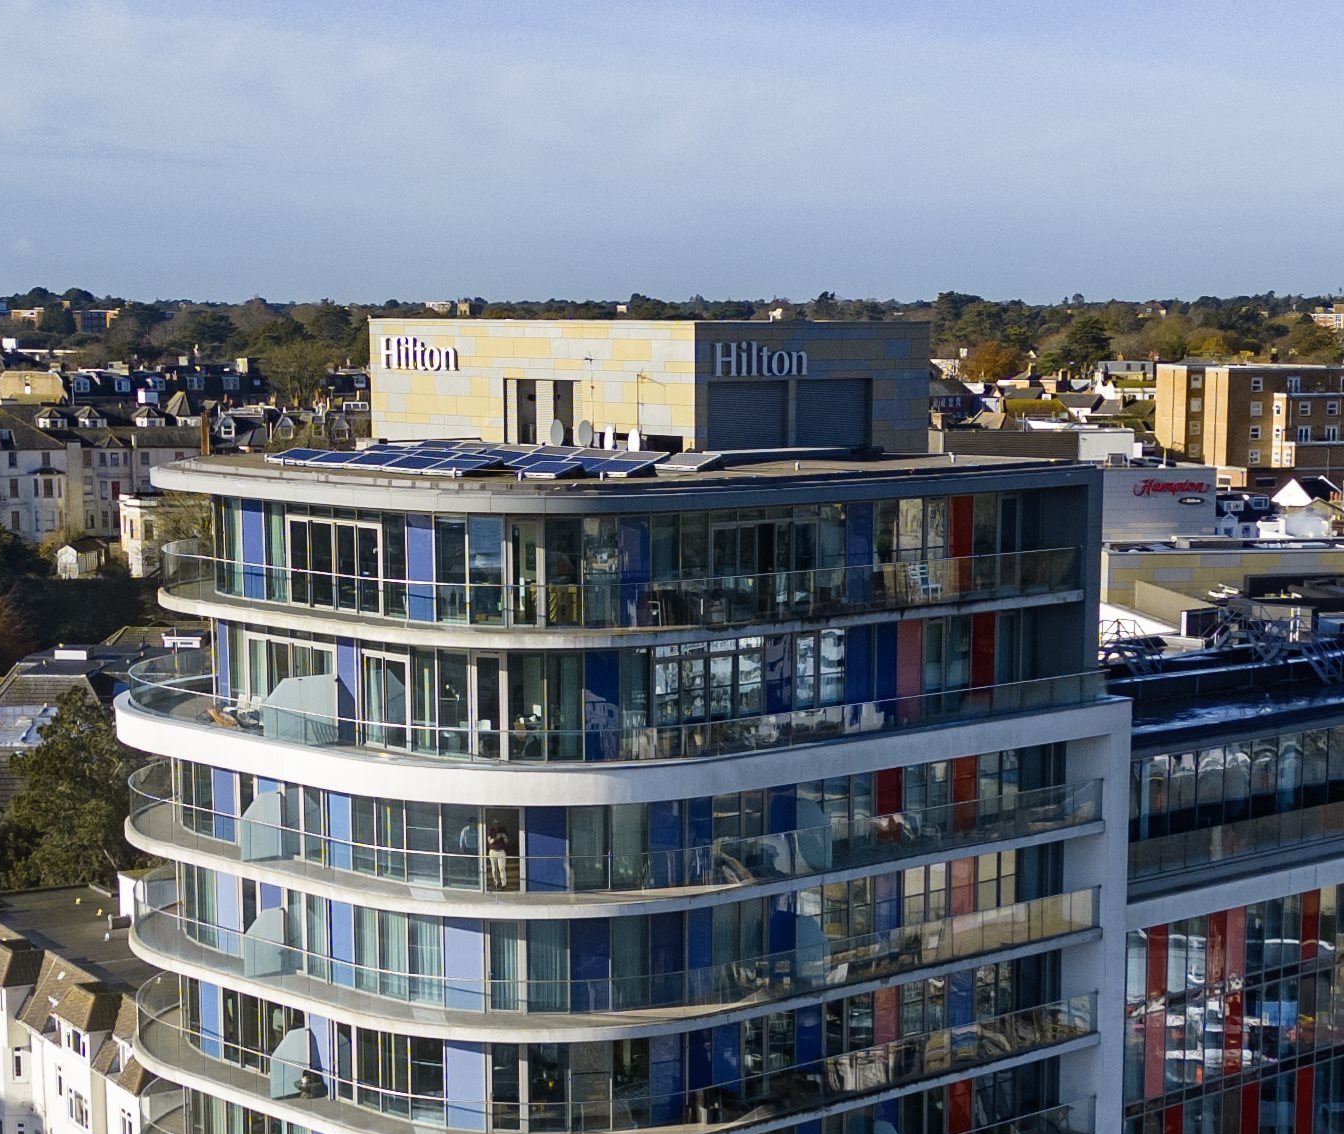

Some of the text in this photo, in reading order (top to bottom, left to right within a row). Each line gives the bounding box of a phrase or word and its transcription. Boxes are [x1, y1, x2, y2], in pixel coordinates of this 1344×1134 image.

[380, 336, 460, 371] Hilton
[713, 340, 809, 377] Hilton
[1133, 479, 1210, 496] Hampton
